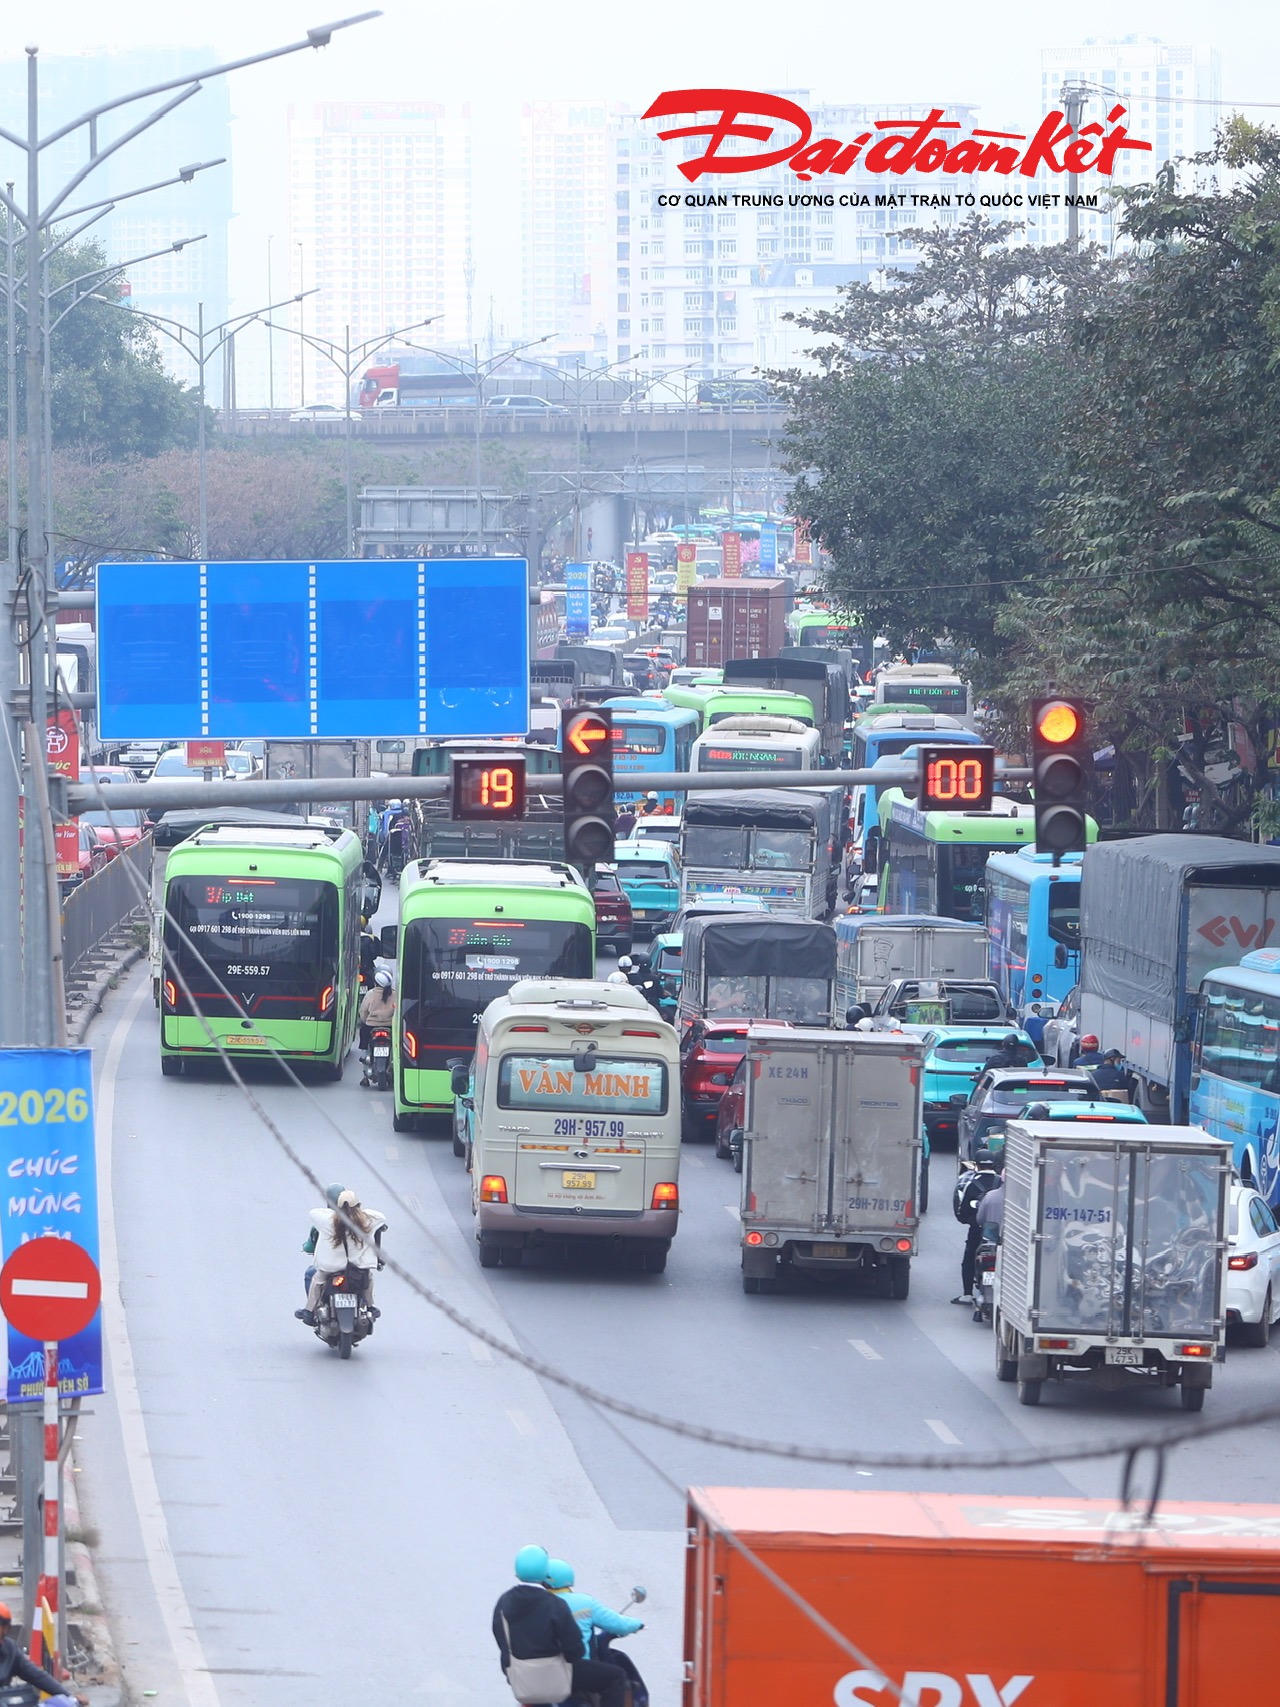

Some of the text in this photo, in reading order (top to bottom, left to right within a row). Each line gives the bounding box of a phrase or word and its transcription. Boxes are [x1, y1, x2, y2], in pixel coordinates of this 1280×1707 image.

[481, 767, 514, 808] 19
[227, 965, 270, 976] 29E-559.57
[518, 1064, 651, 1099] VĂN MINH
[768, 1067, 783, 1078] XE
[7, 1149, 80, 1178] CHÚC
